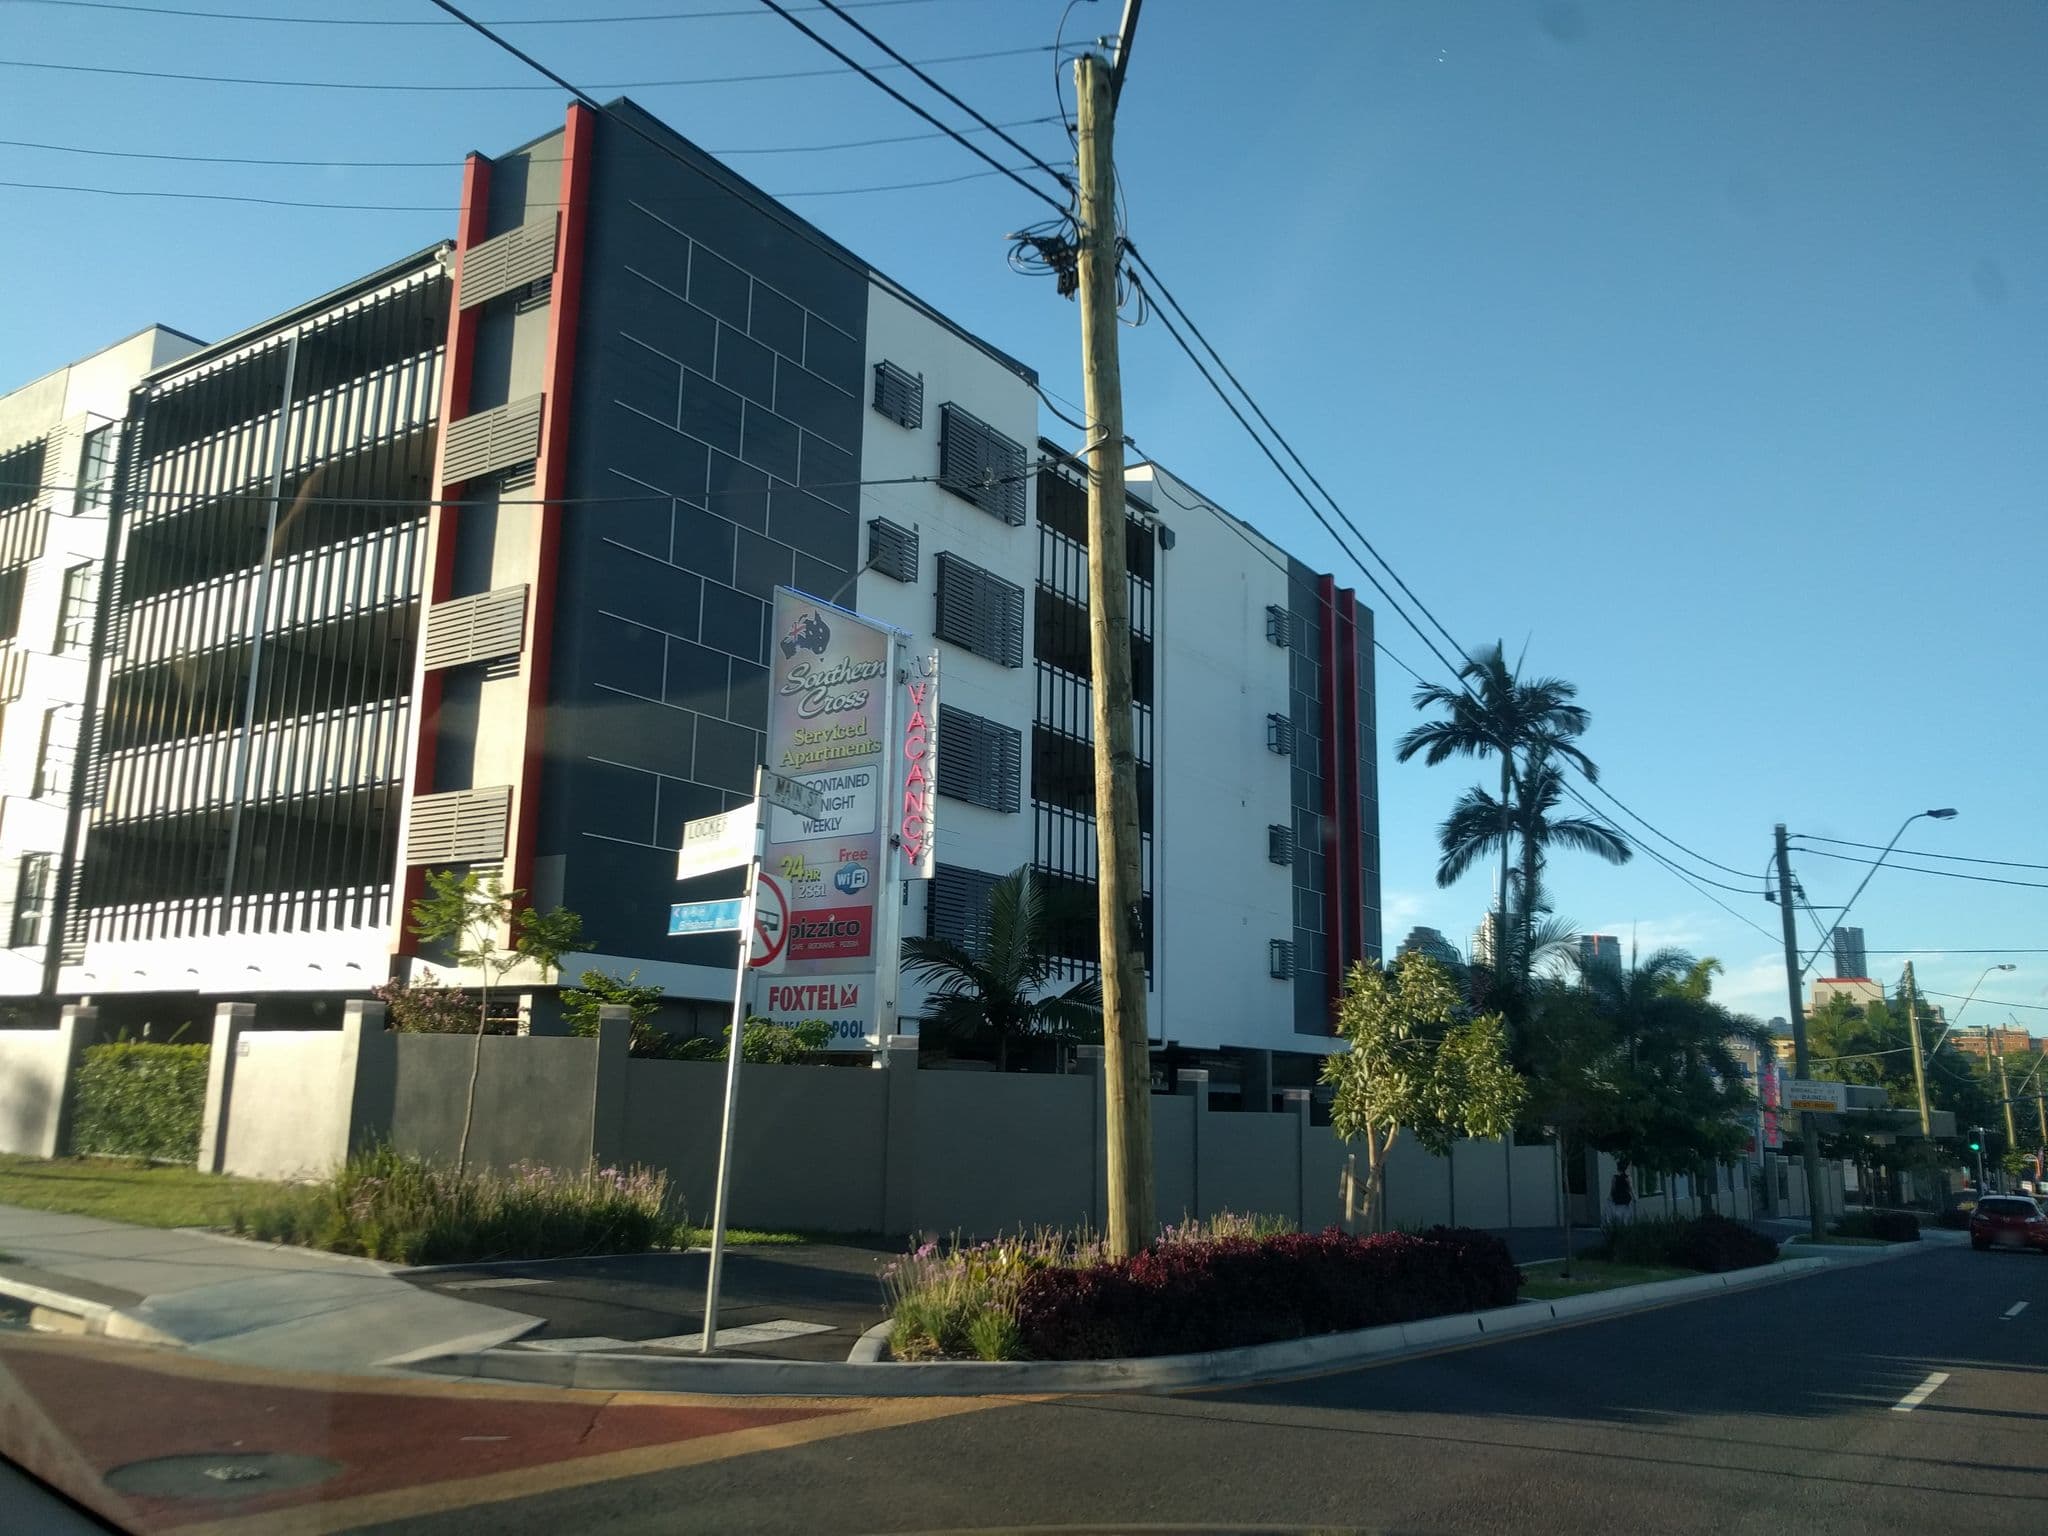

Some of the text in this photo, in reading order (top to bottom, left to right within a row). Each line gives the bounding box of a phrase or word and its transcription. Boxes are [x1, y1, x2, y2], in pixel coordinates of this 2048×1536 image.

[780, 656, 887, 696] Southern
[797, 686, 869, 720] Cross
[792, 717, 868, 747] Serviced
[779, 738, 882, 769] Apartments
[902, 682, 927, 866] VACANCY
[820, 795, 855, 813] NIGHT
[802, 816, 842, 834] WEEKLY
[839, 848, 868, 863] Free
[788, 915, 861, 956] pizzico
[768, 983, 839, 1011] FOXTEL
[832, 1020, 866, 1040] POOL
